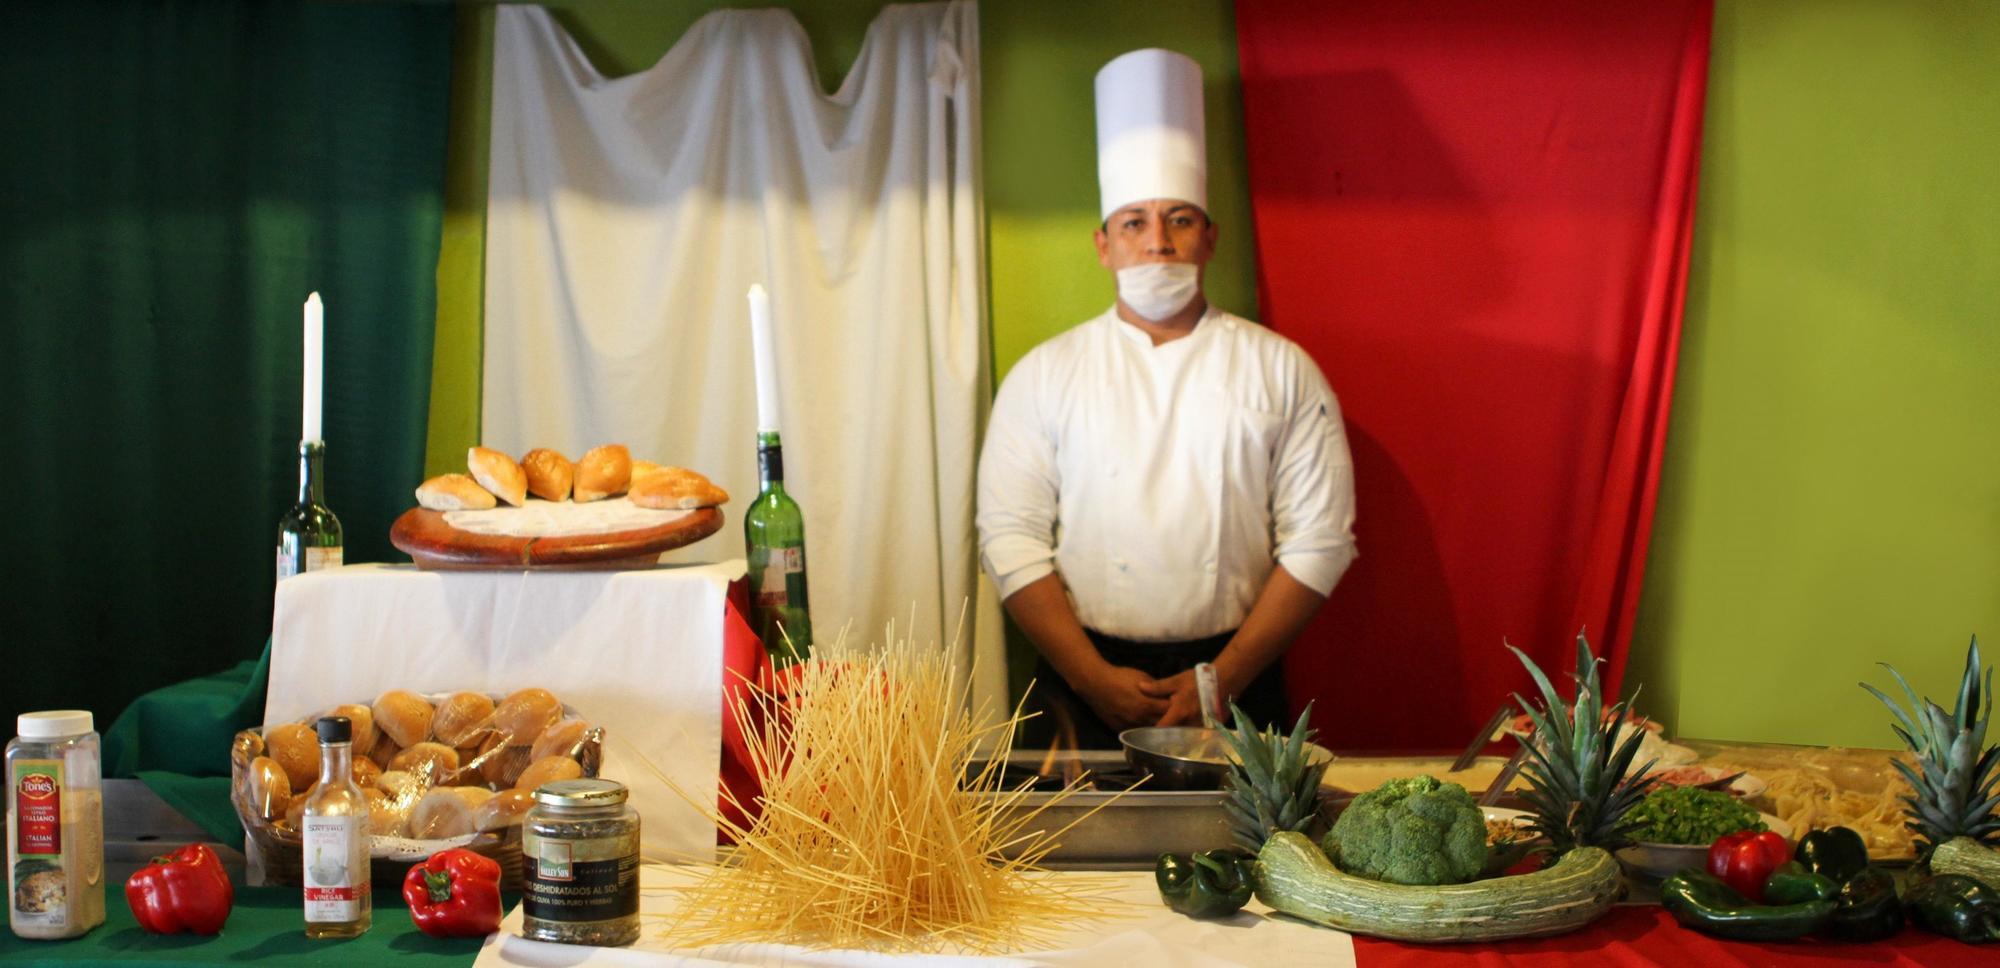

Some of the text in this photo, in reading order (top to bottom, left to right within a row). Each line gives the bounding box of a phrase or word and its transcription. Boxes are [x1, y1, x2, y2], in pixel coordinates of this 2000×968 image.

[23, 781, 52, 791] Tone's
[533, 882, 591, 896] DESHIDRATADOS
[593, 886, 602, 895] AL
[604, 884, 617, 893] SOL
